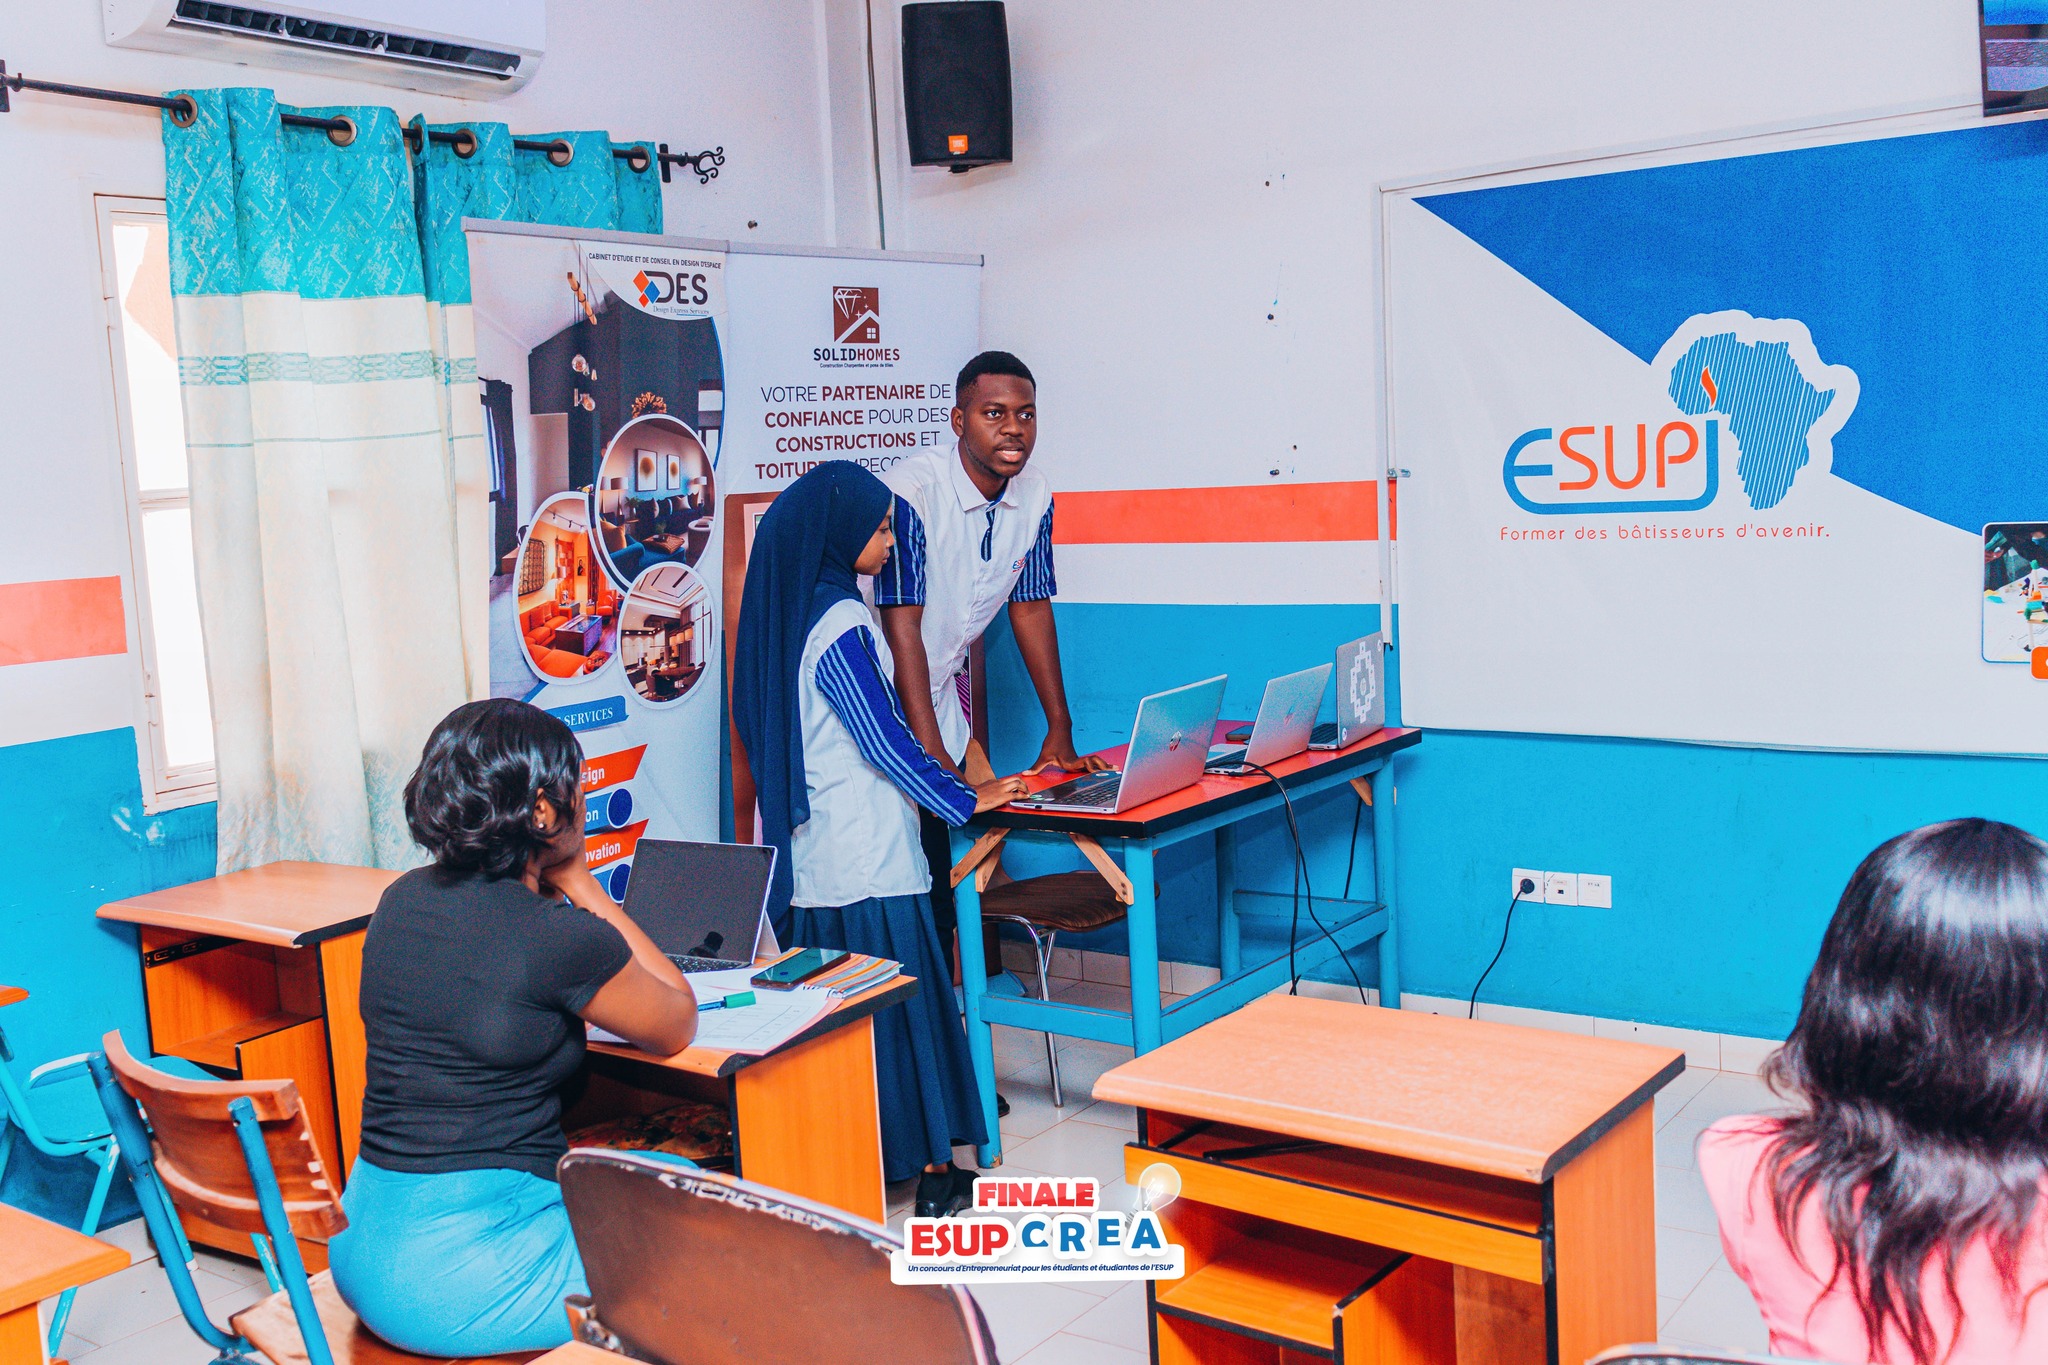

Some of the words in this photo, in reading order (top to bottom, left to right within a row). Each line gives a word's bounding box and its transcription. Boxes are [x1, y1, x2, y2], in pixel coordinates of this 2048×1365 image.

[589, 252, 611, 260] CABINET
[612, 254, 634, 262] D'ETUDE
[651, 257, 671, 265] CONSEIL
[701, 261, 722, 269] D'ESPACE
[643, 270, 708, 305] DES
[814, 348, 900, 361] SOLIDHOMES
[760, 386, 817, 402] VOTRE
[822, 384, 925, 401] PARTENAIRE
[930, 384, 951, 399] DE
[765, 410, 864, 428] CONFIANCE
[869, 408, 913, 424] POUR
[918, 407, 949, 423] DES
[776, 432, 916, 453] CONSTRUCTIONS
[921, 431, 940, 446] ET
[1500, 526, 1565, 541] Former
[1574, 526, 1608, 539] des
[1618, 524, 1725, 539] bâtisseurs
[1736, 523, 1830, 538] d'avenir.
[564, 707, 613, 726] SERVICES
[582, 767, 605, 785] sign
[586, 842, 621, 863] ovation
